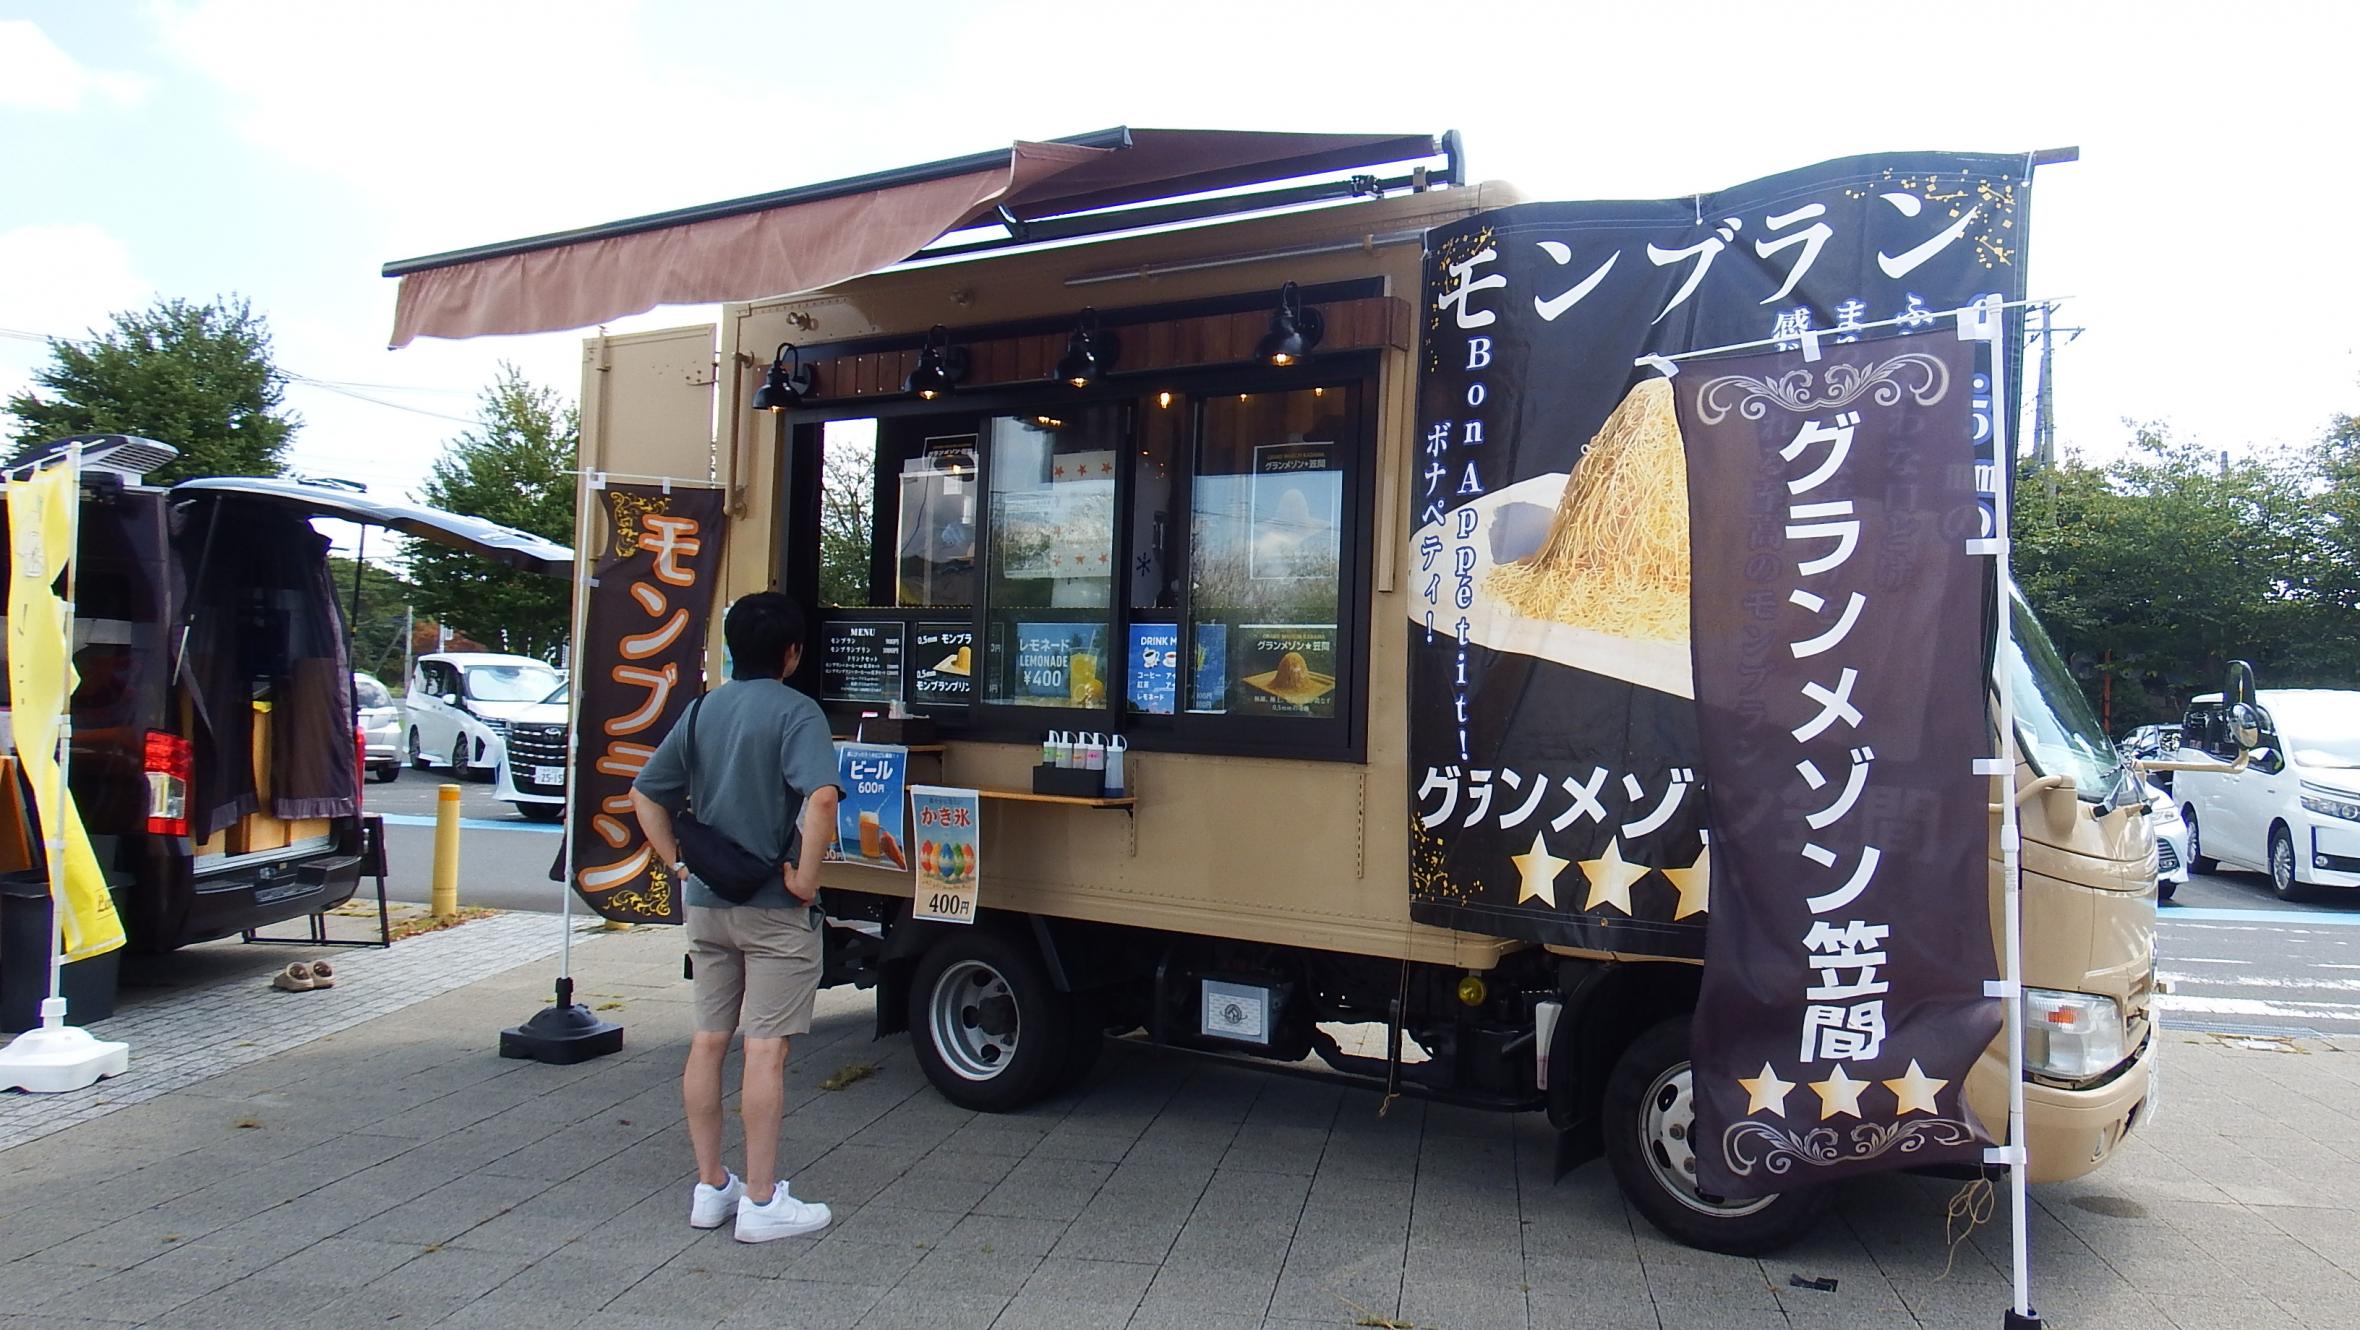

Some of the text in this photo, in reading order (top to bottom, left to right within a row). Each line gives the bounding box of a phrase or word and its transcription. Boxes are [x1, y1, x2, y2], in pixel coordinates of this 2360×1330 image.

[1438, 192, 1978, 328] モンブラン
[1464, 338, 1492, 444] Bon
[850, 627, 876, 637] MENU
[917, 635, 938, 645] 0.5mm
[1019, 638, 1070, 652] レモネード
[1140, 636, 1168, 646] DRINK
[1020, 655, 1069, 668] LEMONADE
[916, 669, 937, 679] 0.5mm
[1023, 670, 1062, 687] ¥400
[1137, 671, 1162, 679] コーヒー
[578, 514, 701, 892] モンブラン
[1779, 411, 1890, 1063] グランメゾン笠間
[850, 760, 894, 781] ビール
[857, 781, 885, 795] 600円
[921, 805, 971, 827] かき氷
[929, 894, 970, 916] 400円
